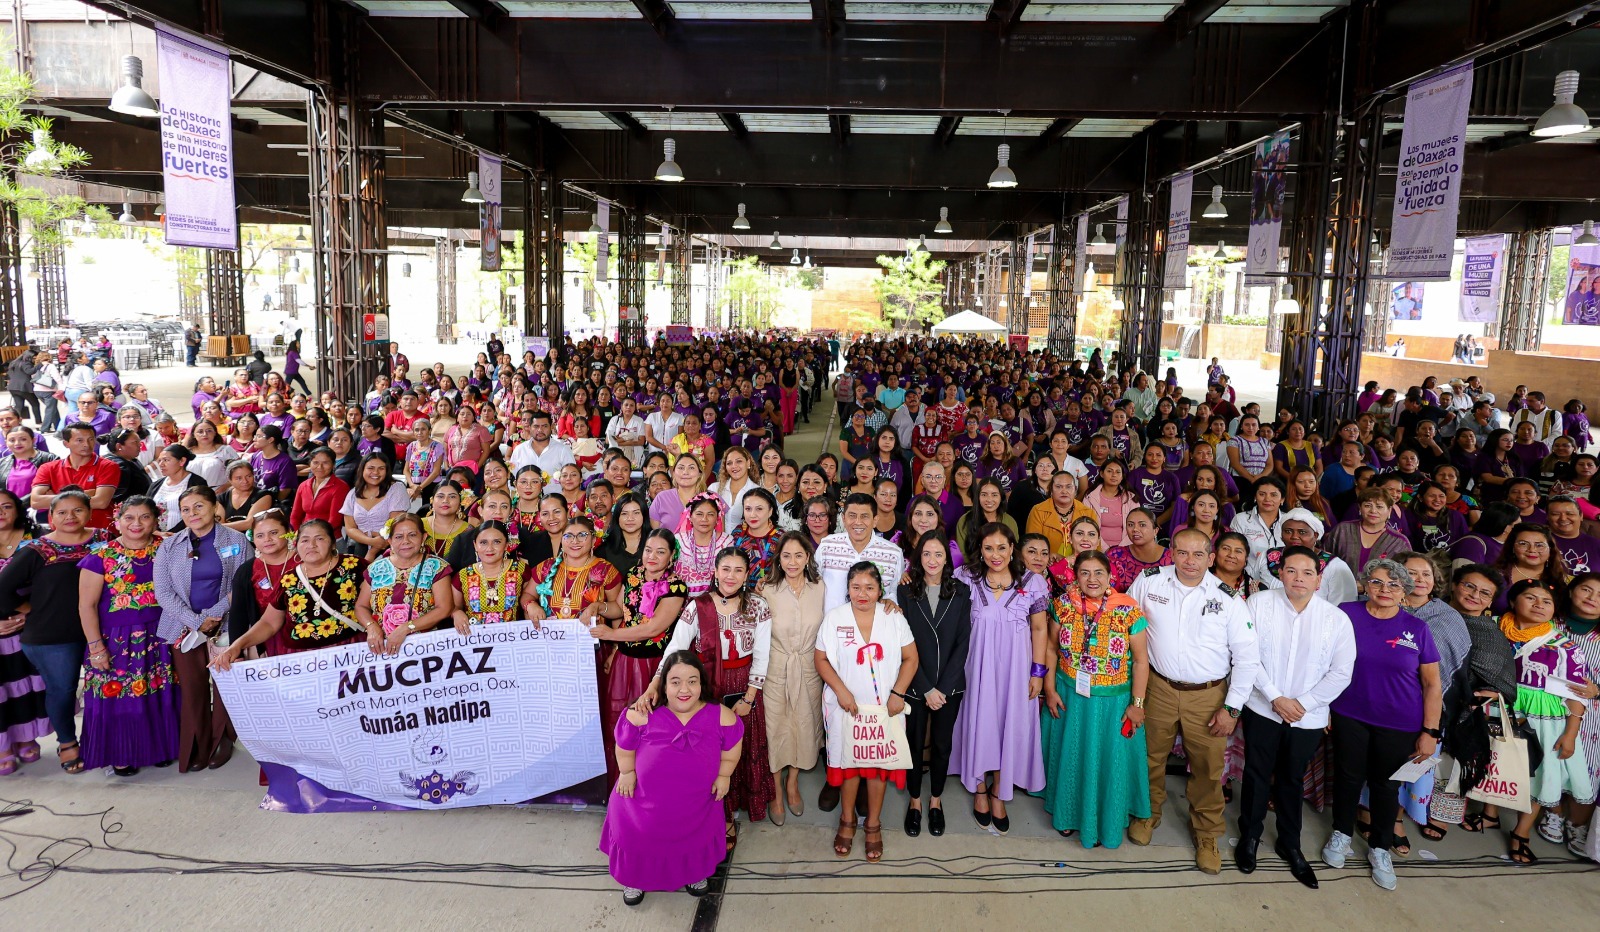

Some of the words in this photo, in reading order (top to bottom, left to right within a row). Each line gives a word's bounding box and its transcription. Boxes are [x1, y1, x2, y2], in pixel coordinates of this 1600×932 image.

[162, 103, 177, 116] La
[163, 131, 174, 139] es
[177, 134, 192, 143] una
[180, 118, 221, 139] Oaxaca
[163, 140, 176, 149] de
[1407, 145, 1419, 155] Las
[164, 151, 228, 179] fuertes
[1403, 155, 1416, 167] de
[1413, 162, 1459, 181] ejemplo
[1401, 179, 1412, 187] de
[1404, 176, 1450, 197] unidad
[1405, 194, 1445, 210] fuerza
[245, 663, 301, 682] Redes
[306, 657, 328, 673] de
[403, 631, 516, 657] Constructoras
[520, 626, 539, 640] de
[542, 626, 566, 640] Paz
[337, 646, 497, 699] MUCPAZ
[317, 700, 366, 720] Santa
[422, 681, 484, 699] Petapa,
[487, 677, 520, 690] Oax.
[359, 710, 419, 735] Gunáa
[424, 700, 491, 726] Nadipa
[865, 714, 878, 724] LAS
[853, 725, 885, 740] OAXA
[853, 740, 897, 760] QUEÑAS
